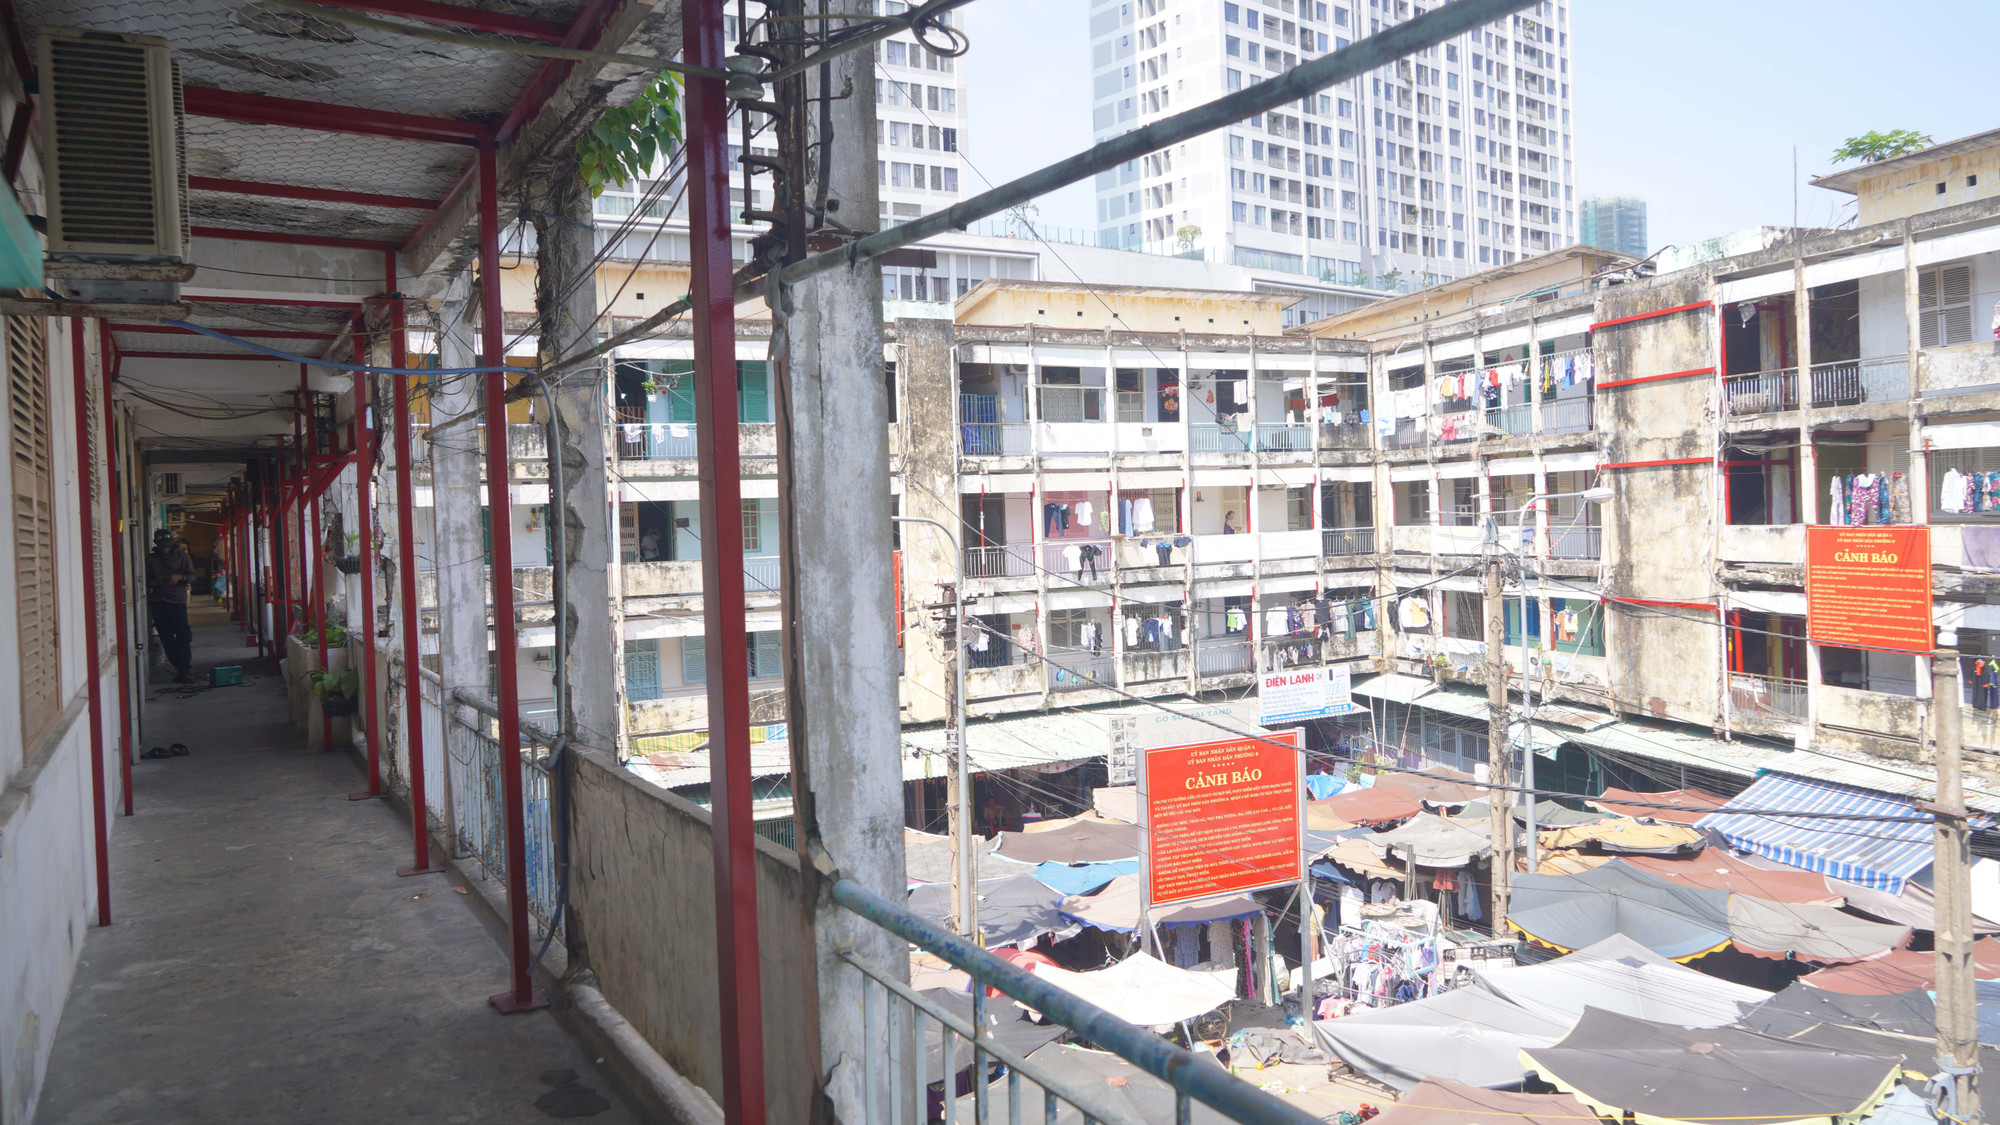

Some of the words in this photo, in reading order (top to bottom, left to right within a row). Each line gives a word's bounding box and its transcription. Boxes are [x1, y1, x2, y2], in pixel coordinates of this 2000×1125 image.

[1834, 548, 1868, 562] CẢNH
[1871, 550, 1898, 564] BÁO
[1266, 675, 1286, 688] ĐIỆN
[1290, 673, 1314, 686] LẠNH
[1185, 772, 1228, 790] CẢNH
[1231, 767, 1262, 784] BÁO
